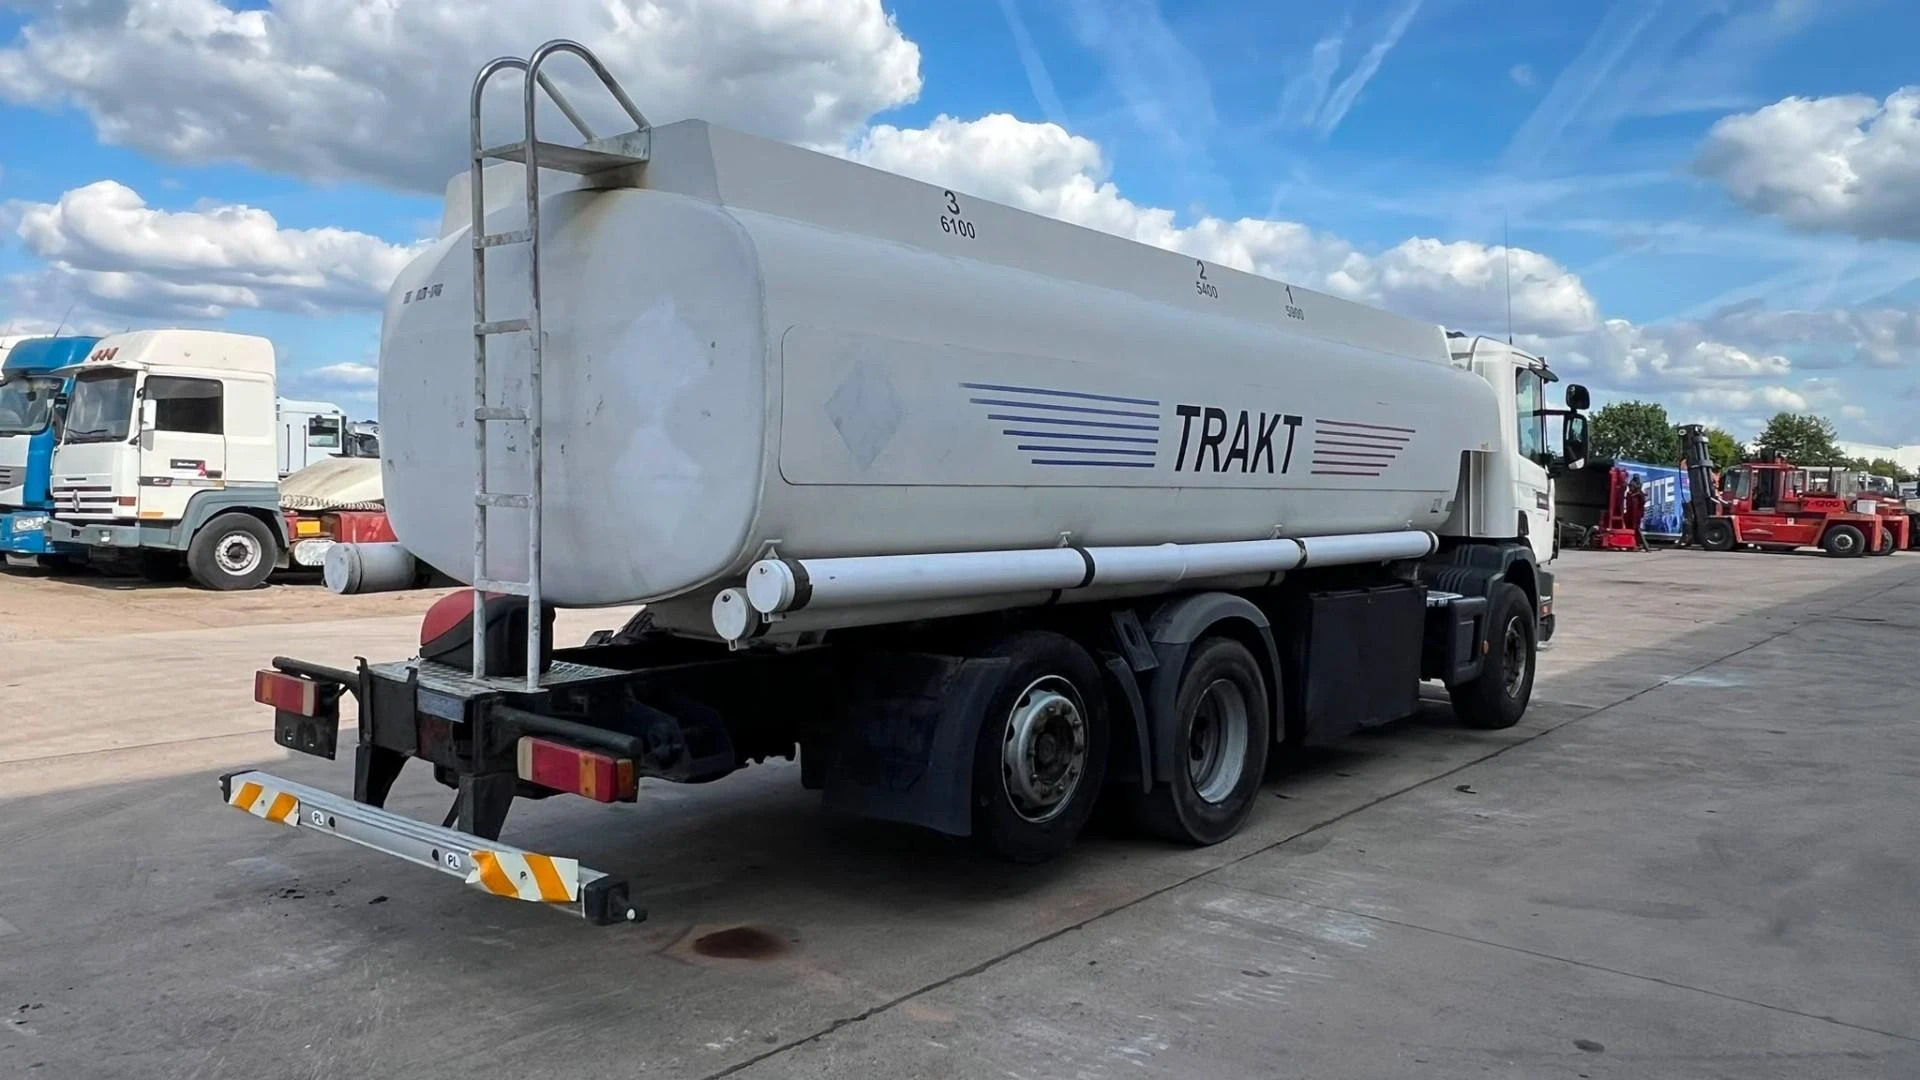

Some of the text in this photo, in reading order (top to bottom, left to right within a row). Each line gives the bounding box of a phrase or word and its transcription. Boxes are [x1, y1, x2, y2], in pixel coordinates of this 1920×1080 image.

[944, 190, 960, 215] 3
[940, 215, 976, 239] 6100
[1197, 260, 1207, 280] 2
[1195, 281, 1218, 298] 5400
[1285, 284, 1293, 304] 1
[1174, 404, 1303, 474] TRAKT
[313, 811, 323, 824] PL
[447, 853, 459, 868] PL
